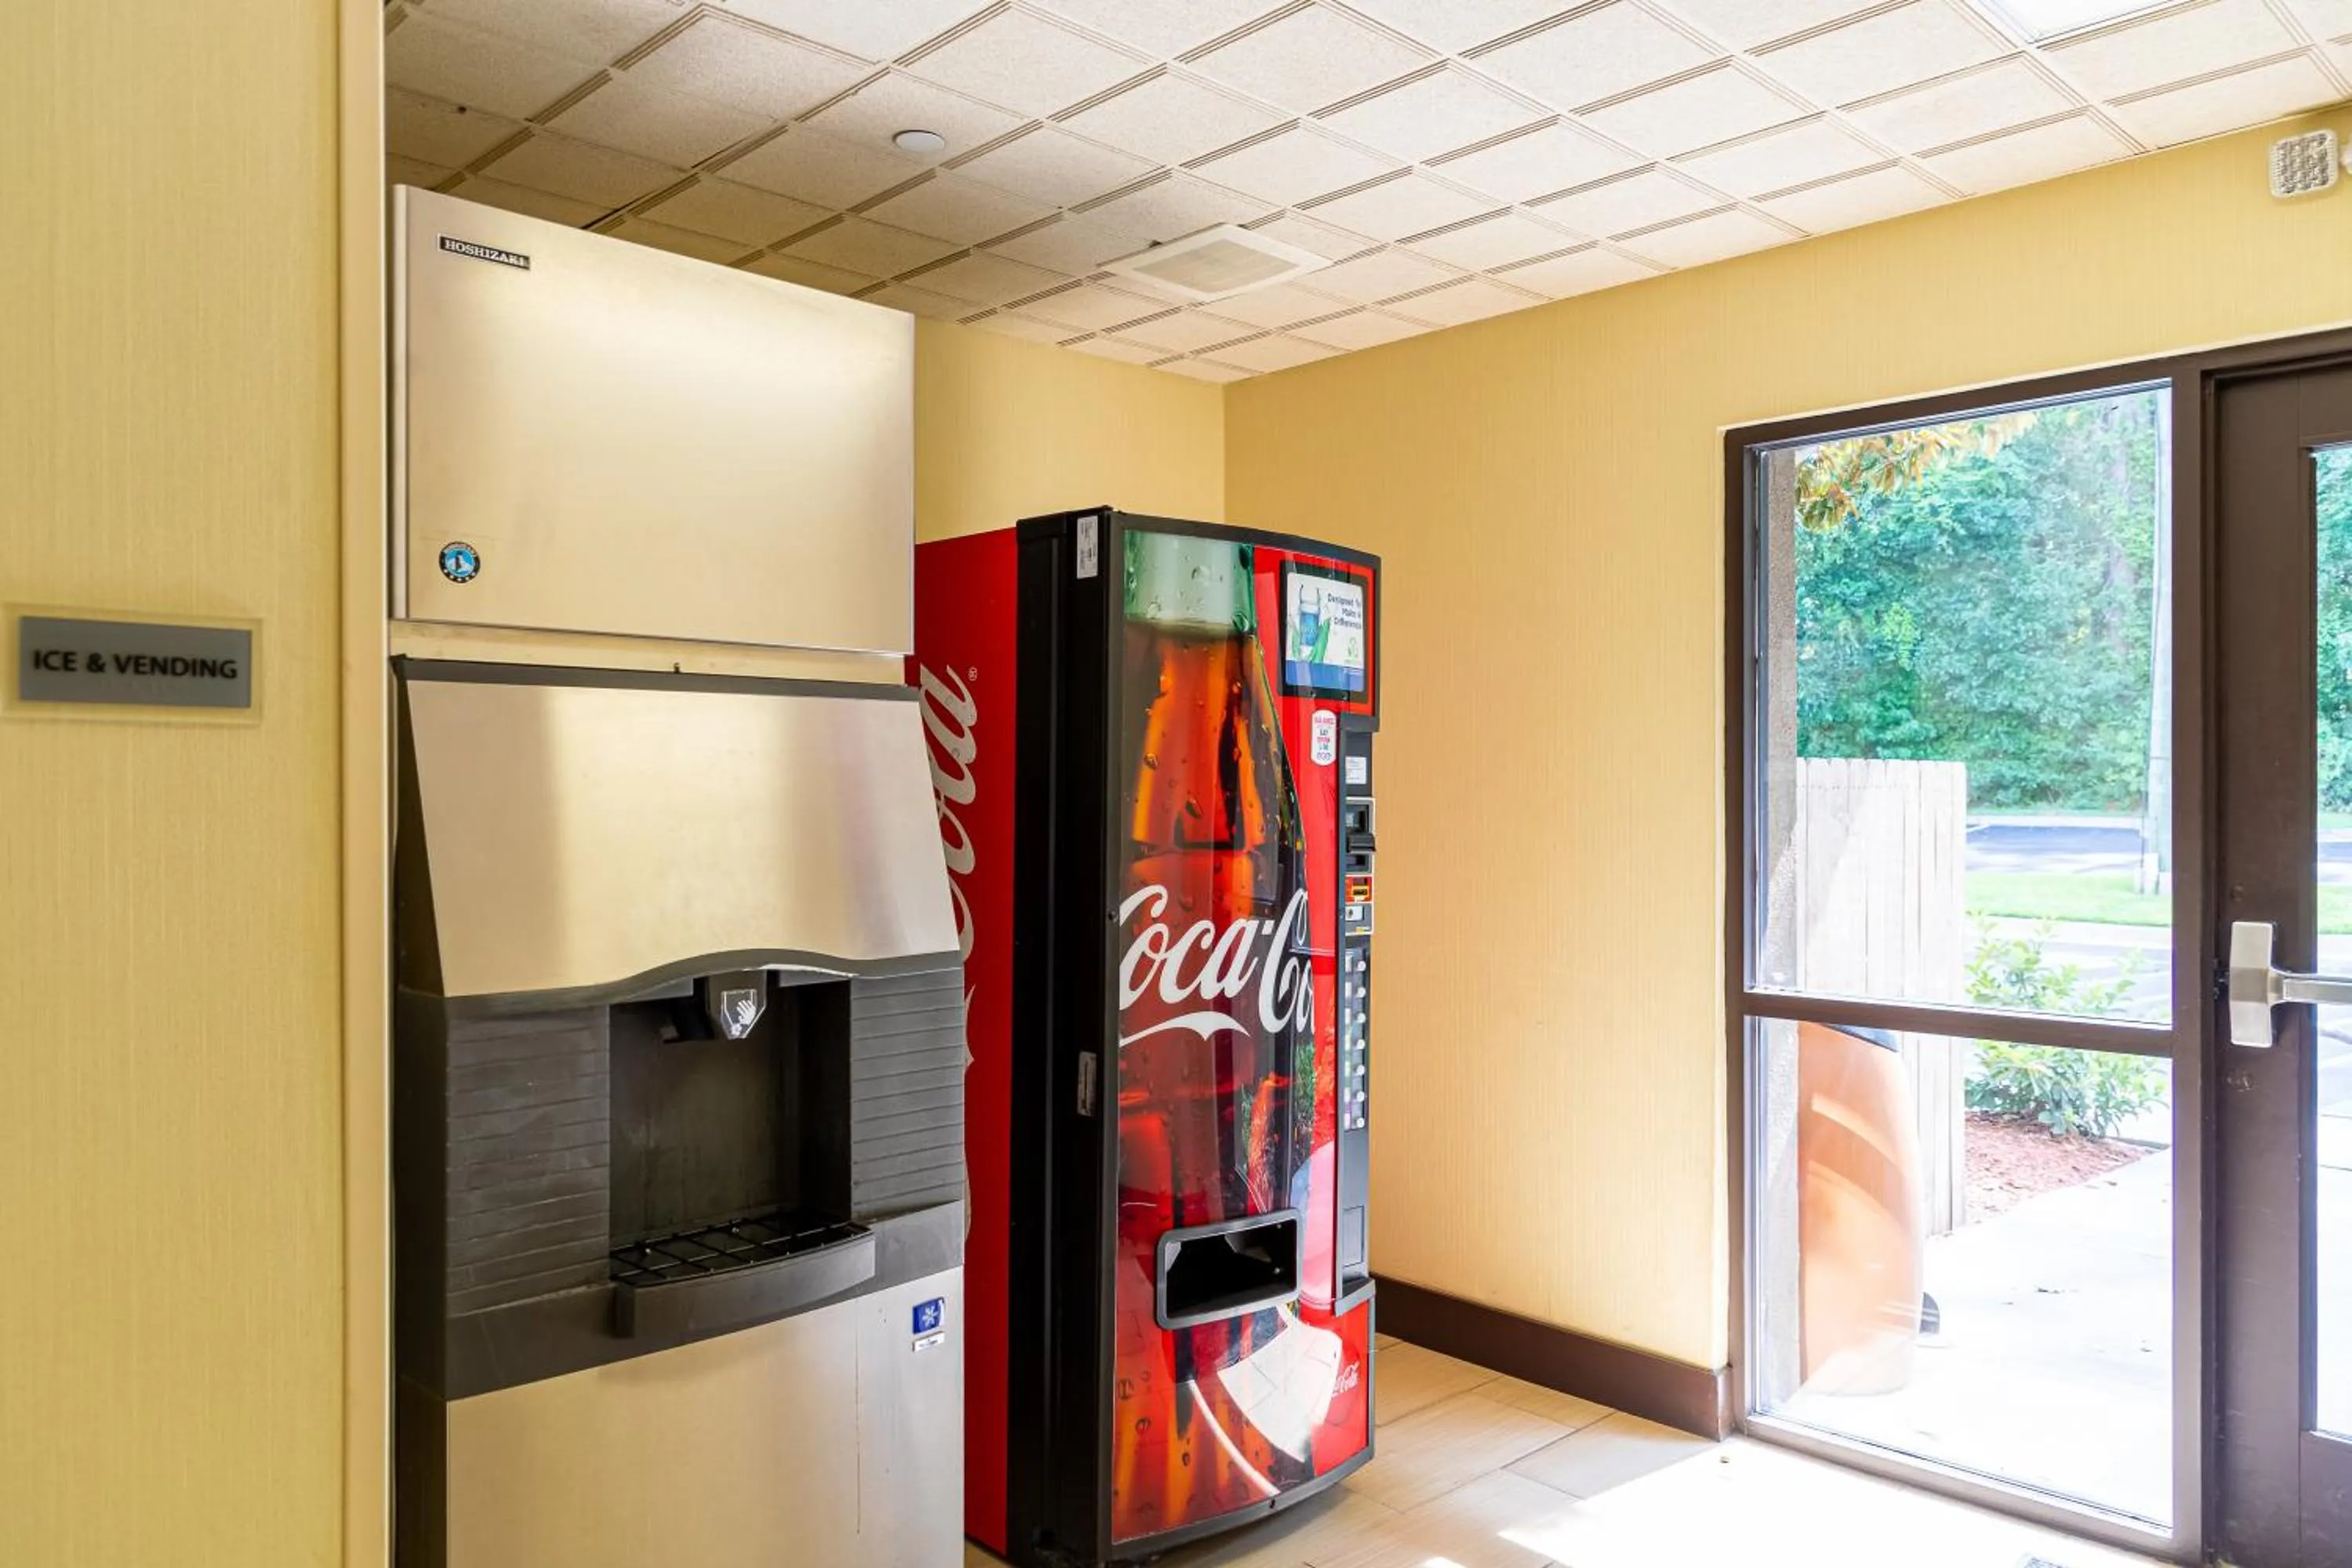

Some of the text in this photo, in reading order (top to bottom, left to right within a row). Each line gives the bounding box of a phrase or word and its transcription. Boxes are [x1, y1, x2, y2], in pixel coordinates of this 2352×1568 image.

[444, 239, 524, 267] HOSHIZAKI
[34, 649, 238, 679] ICE & VENDING
